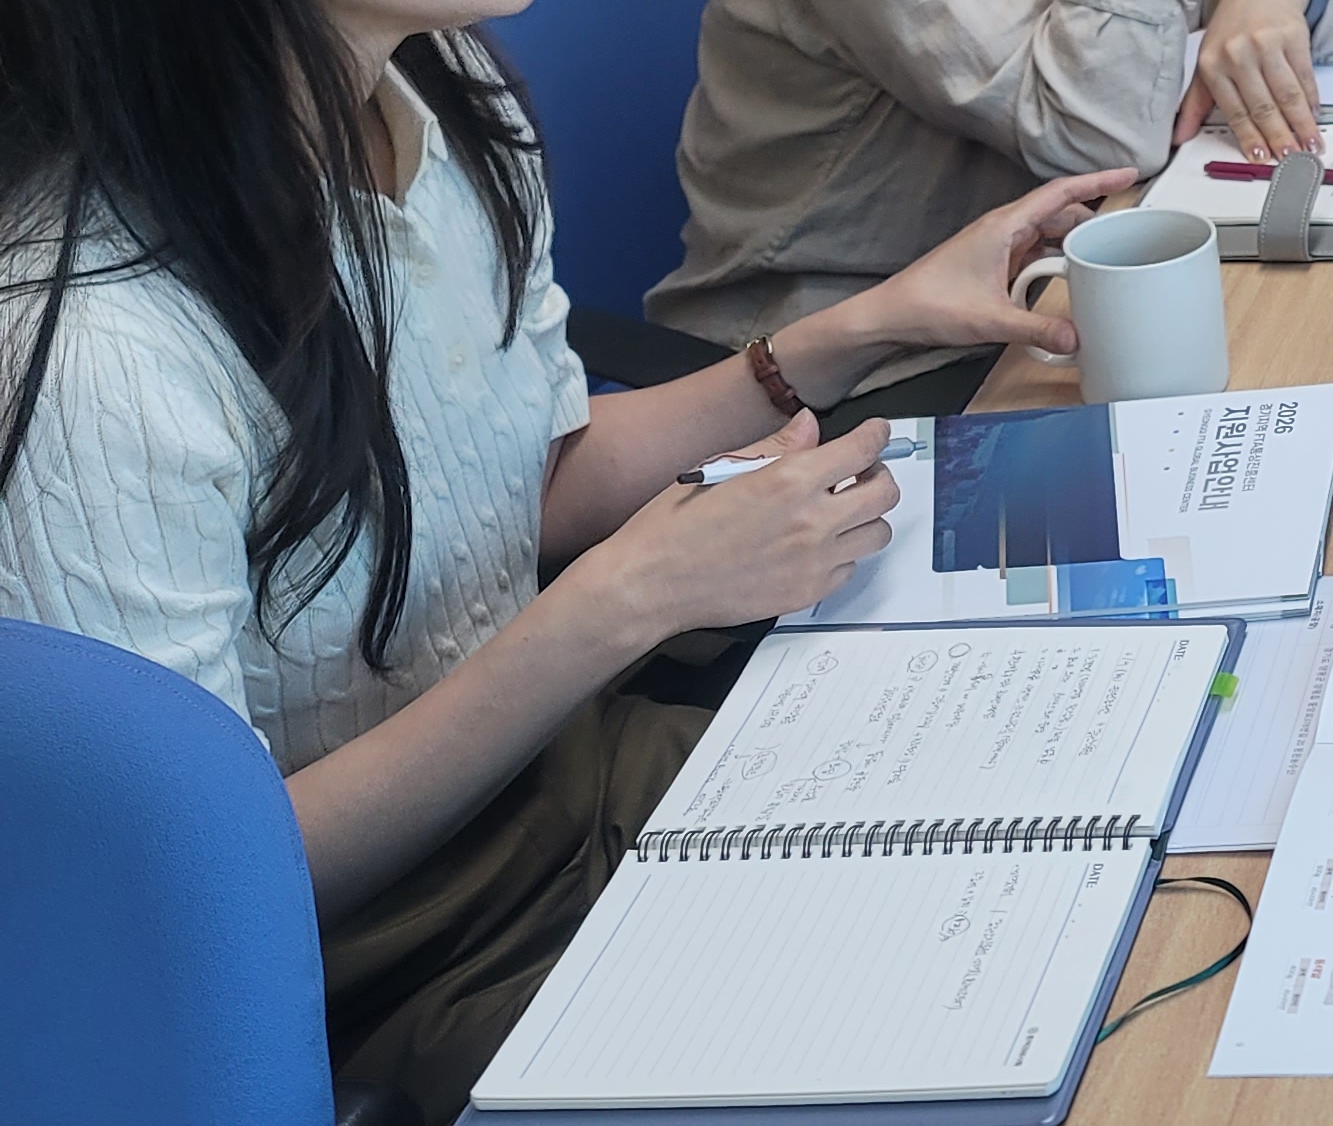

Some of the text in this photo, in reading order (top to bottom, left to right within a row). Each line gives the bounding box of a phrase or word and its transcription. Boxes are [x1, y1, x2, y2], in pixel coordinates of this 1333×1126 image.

[1255, 403, 1273, 432] 경기지역
[1274, 401, 1299, 434] 2026
[1196, 434, 1206, 445] FTA
[1191, 445, 1203, 466] GLOBAL
[1197, 405, 1251, 511] 지원사업안내
[1185, 466, 1198, 492] BUSINESS
[1178, 492, 1192, 513] CENTER
[1174, 639, 1190, 661] DATE:
[1321, 647, 1333, 664] 경기도
[1086, 863, 1104, 888] DATE:
